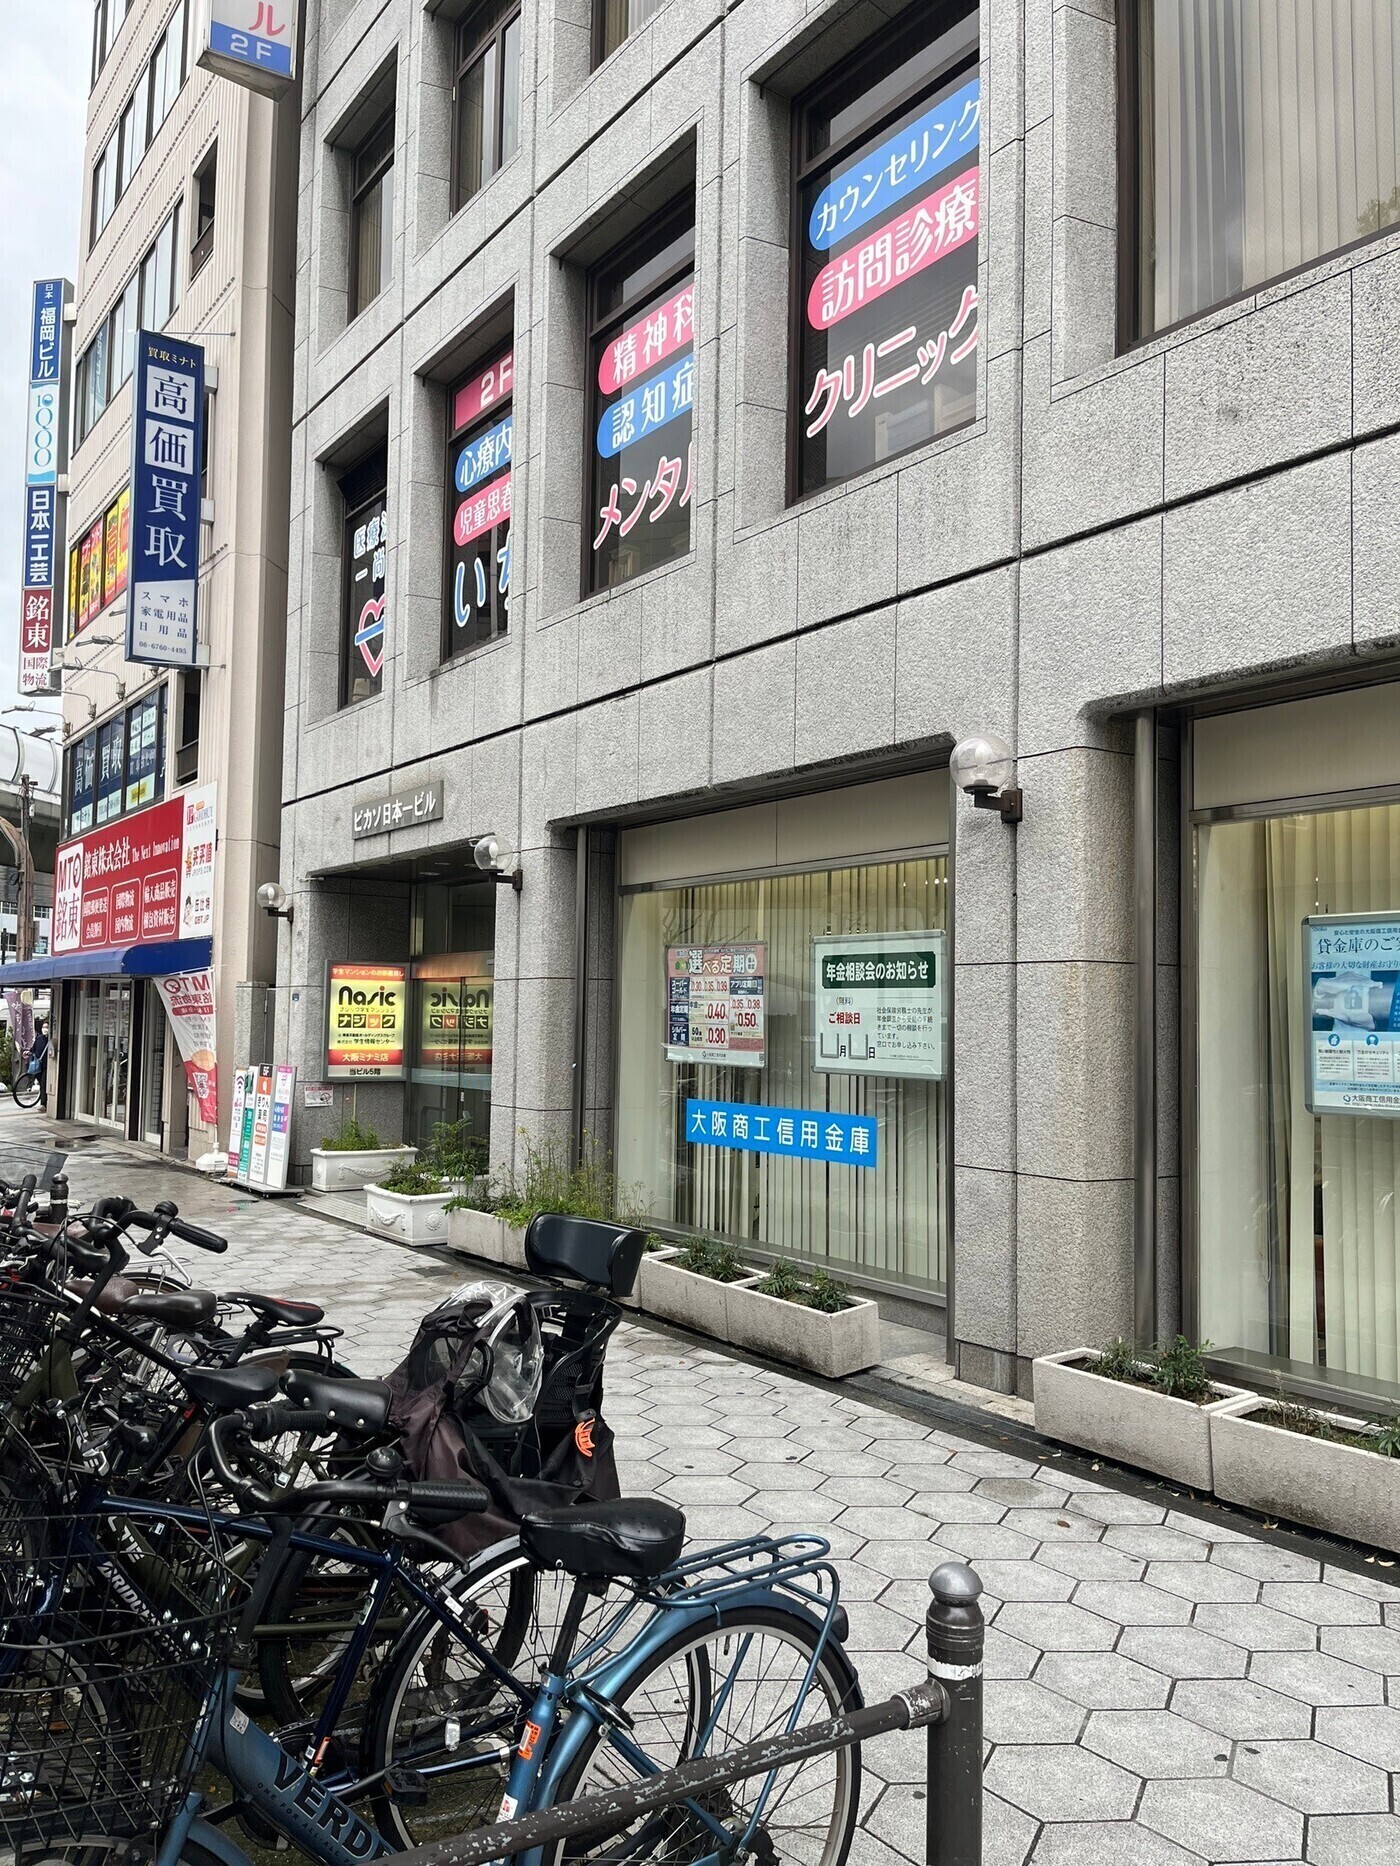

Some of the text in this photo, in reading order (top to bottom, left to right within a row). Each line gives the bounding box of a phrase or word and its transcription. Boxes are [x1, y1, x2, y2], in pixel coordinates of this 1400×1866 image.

[230, 33, 273, 61] 2F
[821, 178, 978, 322] 訪問診療
[612, 286, 694, 385] 精神科
[148, 346, 196, 369] 買取ミナト
[143, 375, 189, 569] 高価買取
[29, 490, 51, 583] 日本一工芸
[142, 590, 189, 609] スマホ
[25, 594, 50, 649] 銘東
[140, 605, 188, 624] 家電用品
[139, 622, 188, 640] 日用品
[23, 657, 48, 671] 国際
[22, 673, 47, 687] 物流
[55, 892, 80, 942] 銘東
[1334, 927, 1400, 936] 安心と安全の大阪商工信用
[688, 948, 745, 975] 選べる定期
[826, 960, 929, 982] 年金相談会のお知らせ
[707, 1003, 726, 1019] 0.40
[737, 1012, 757, 1027] 0.50
[828, 1012, 861, 1025] ご相談日
[338, 1014, 396, 1028] ナジック
[708, 1027, 726, 1044] 0.30
[342, 1052, 389, 1062] 大阪ミナミ店
[840, 1045, 847, 1058] 月
[868, 1046, 876, 1059] 日
[690, 1108, 871, 1156] 大阪商工信用金庫
[257, 1782, 278, 1801] ONE
[279, 1801, 300, 1821] FOR
